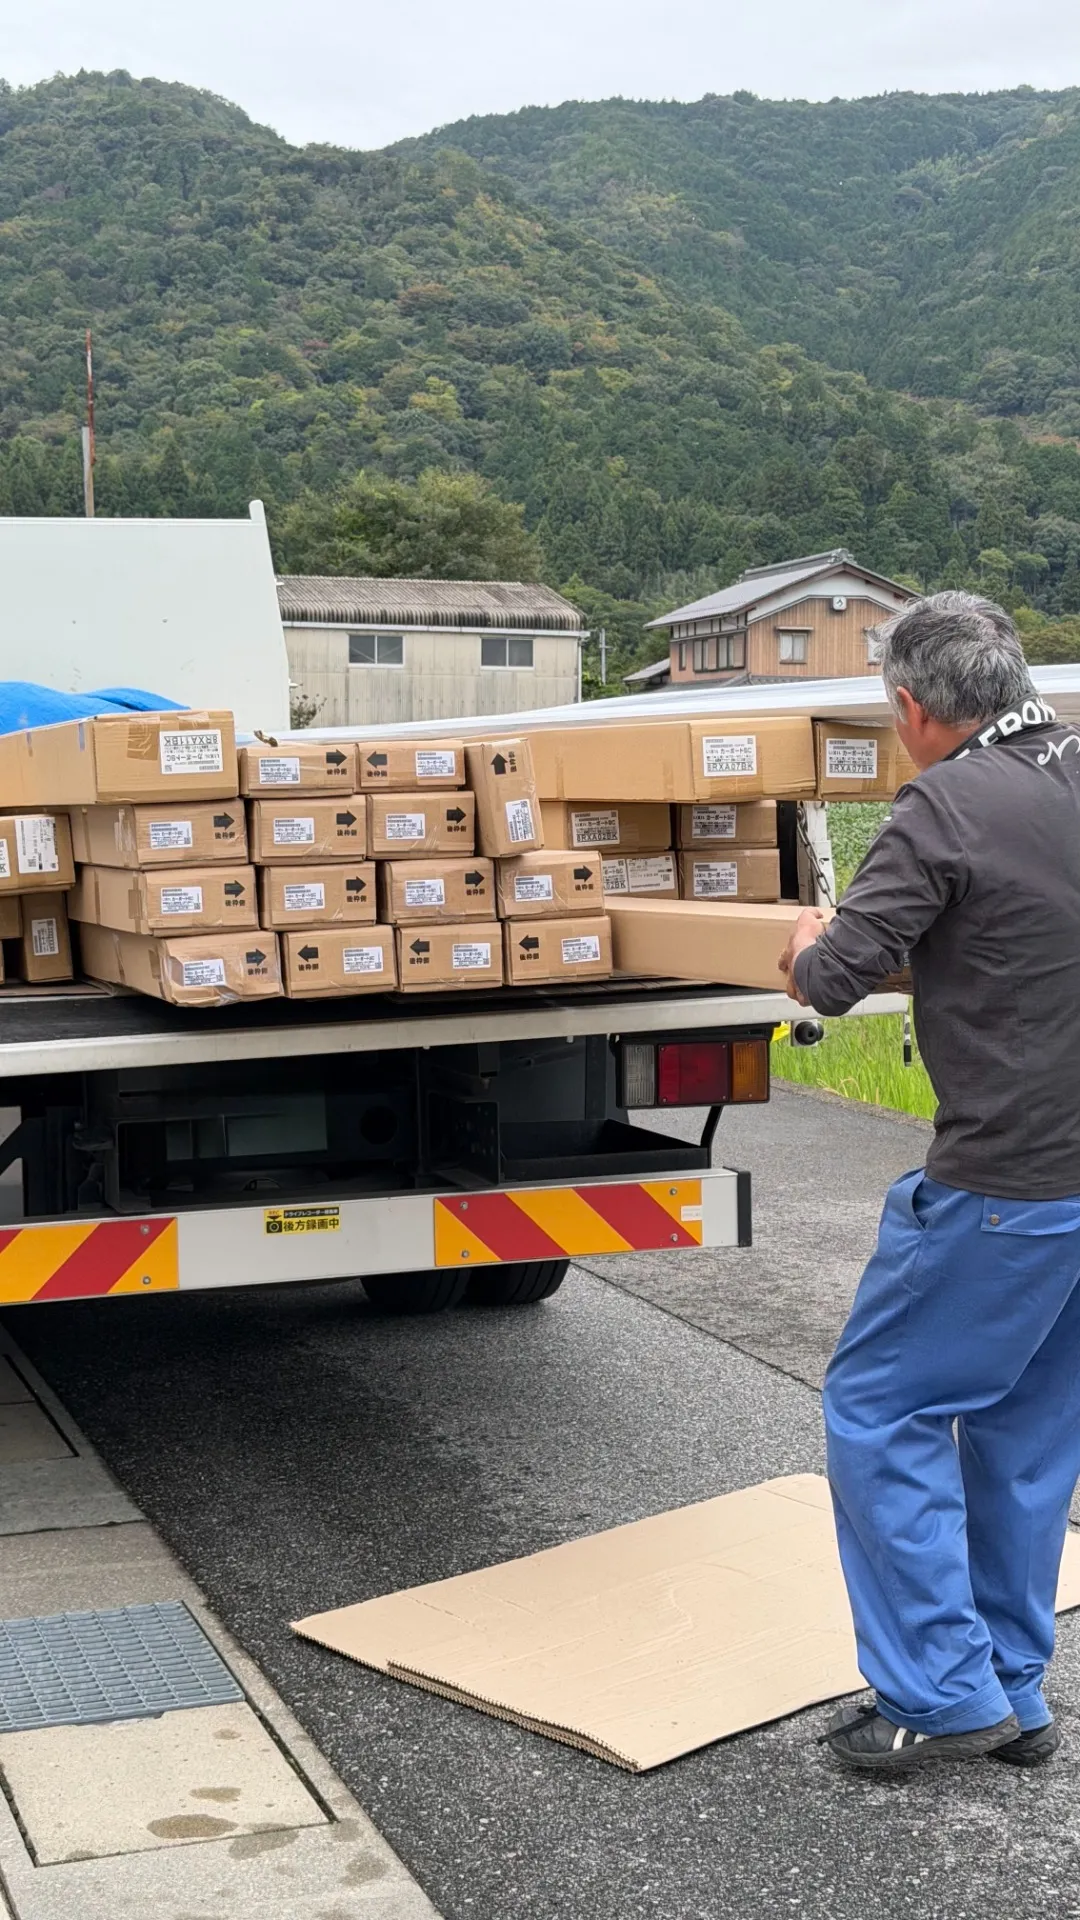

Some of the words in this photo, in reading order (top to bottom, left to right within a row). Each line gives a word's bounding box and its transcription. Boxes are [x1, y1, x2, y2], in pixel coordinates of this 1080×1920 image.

[164, 735, 218, 746] 8RXA11BK
[284, 1218, 339, 1231] 後方録画中
